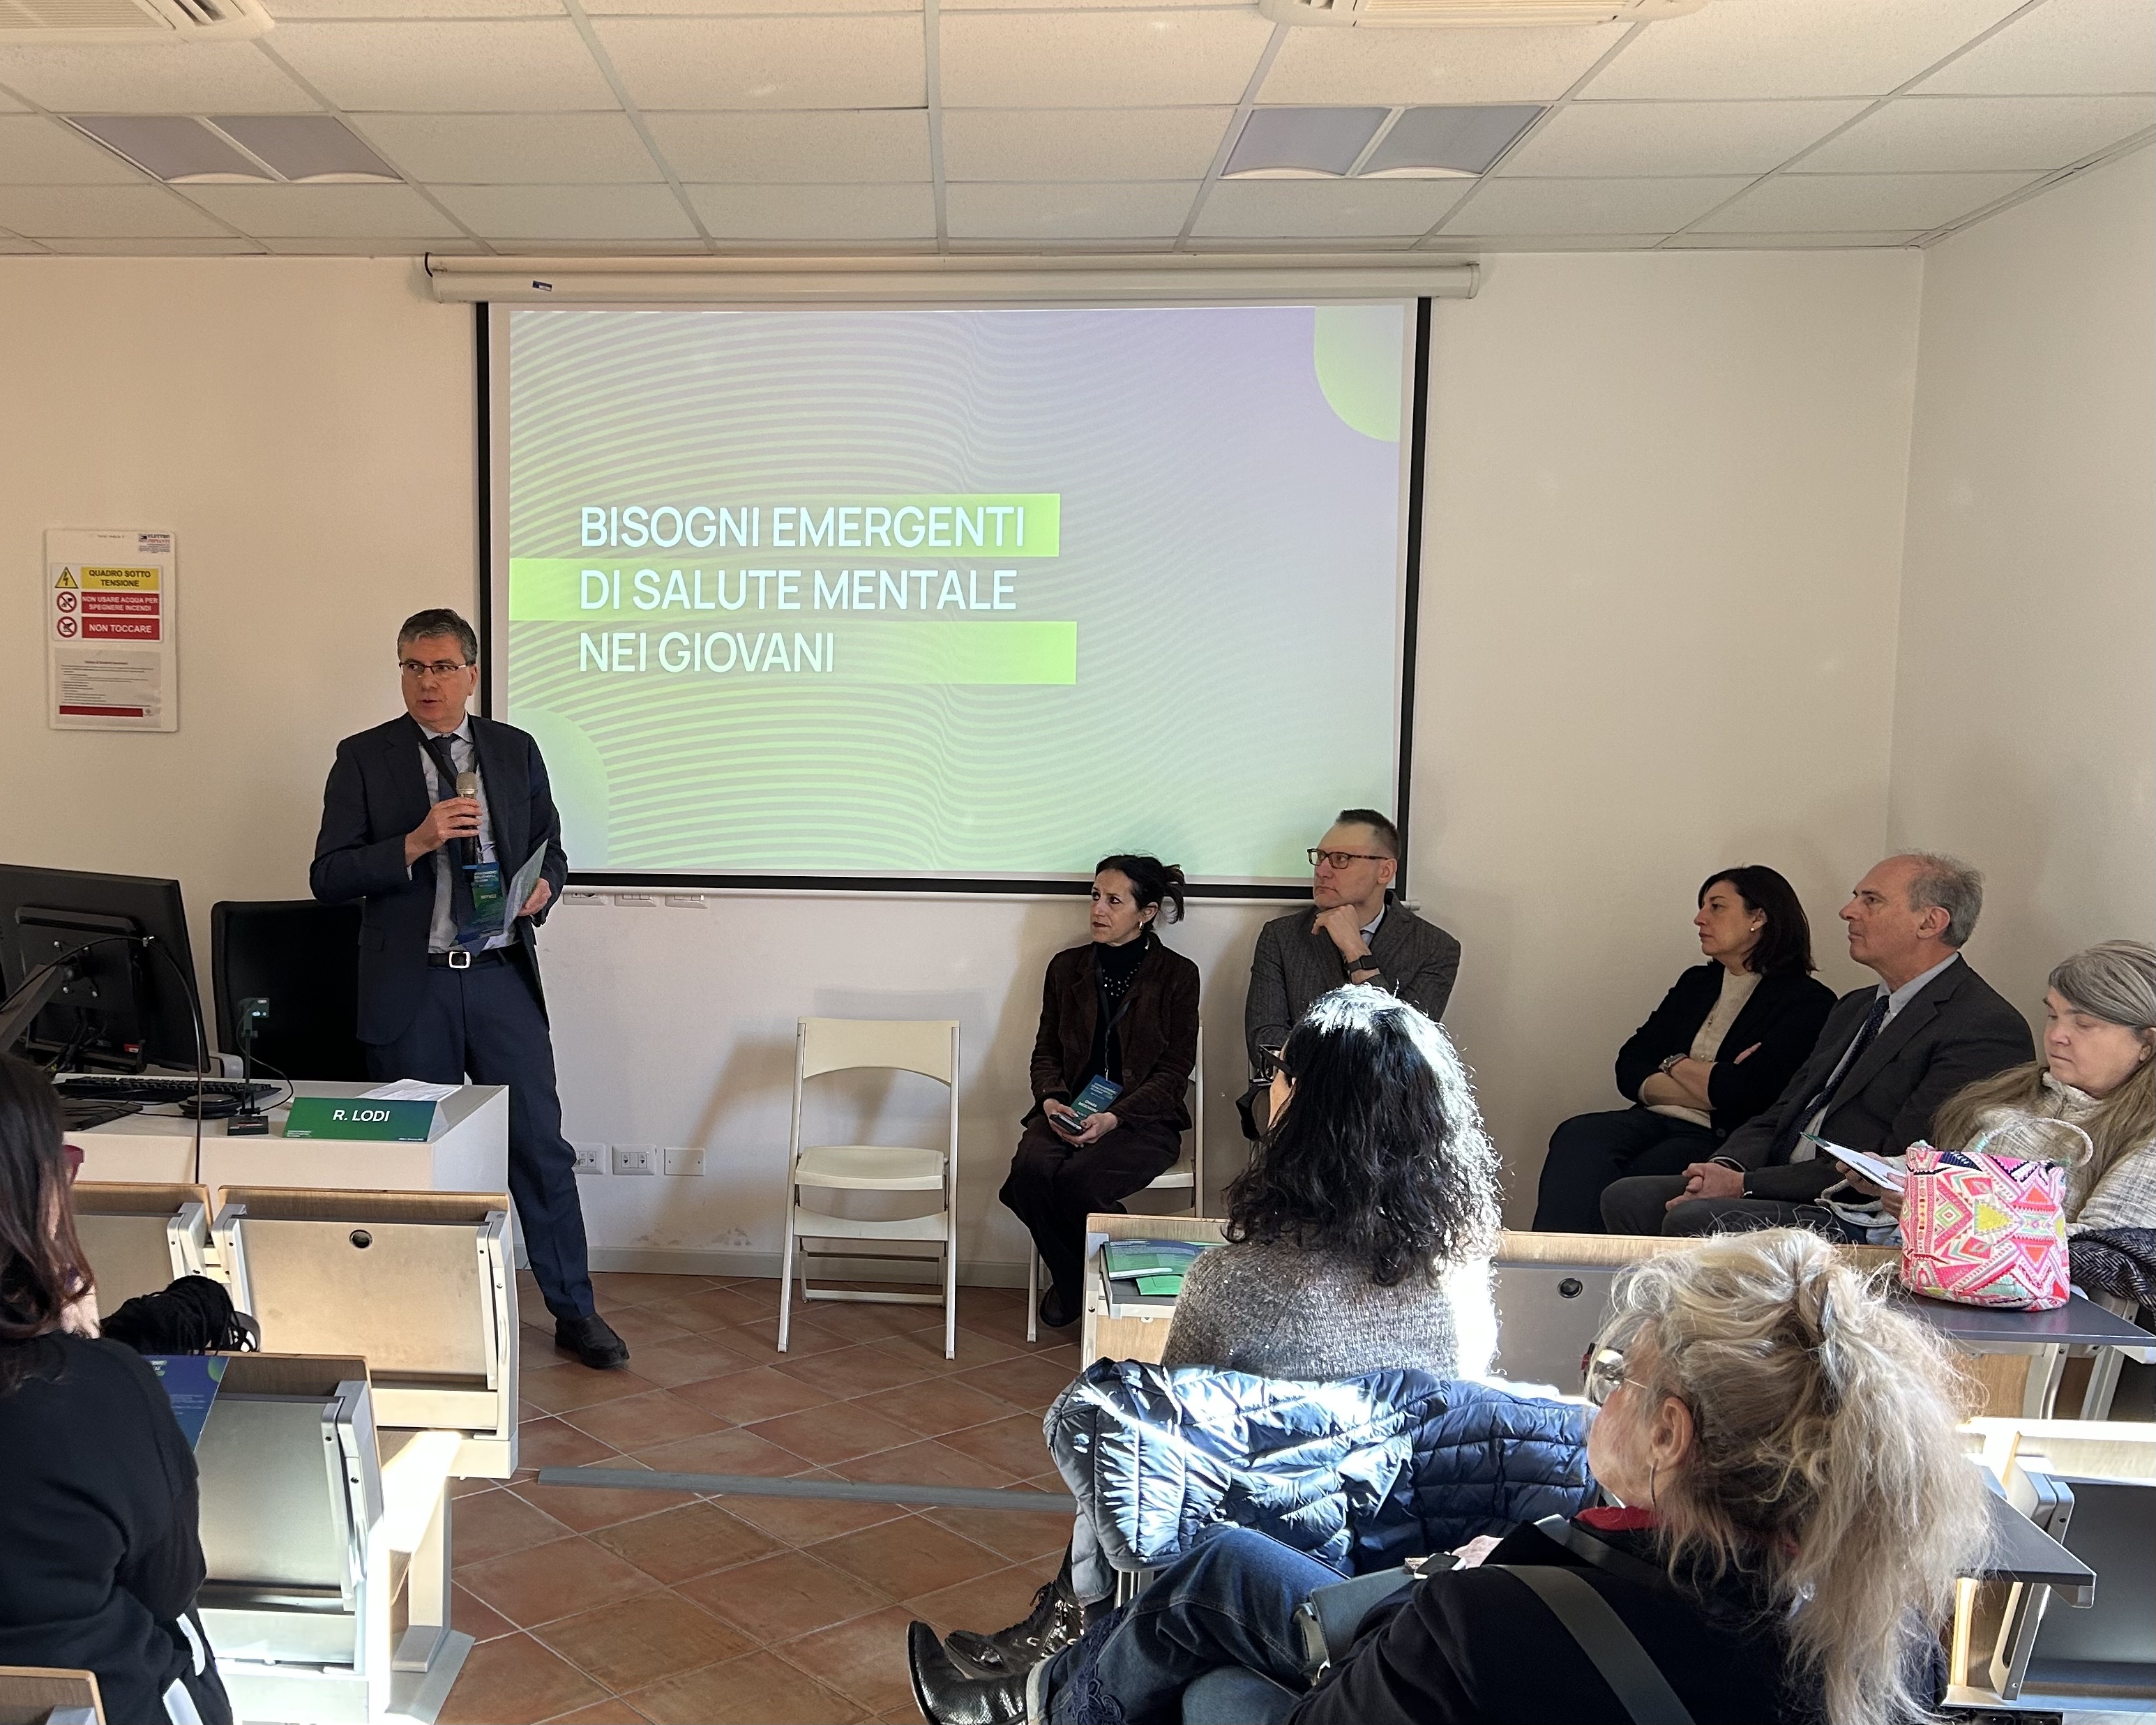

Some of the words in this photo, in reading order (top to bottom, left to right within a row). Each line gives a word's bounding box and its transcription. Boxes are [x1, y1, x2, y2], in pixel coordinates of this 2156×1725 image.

[581, 506, 760, 548] BISOGNI
[773, 506, 1024, 548] EMERGENTI
[89, 569, 123, 578] QUADRO
[100, 579, 140, 587] TENSIONE
[580, 569, 620, 610] DI
[633, 568, 801, 610] SALUTE
[813, 569, 1018, 610] MENTALE
[89, 624, 108, 633] NON
[110, 624, 152, 633] TOCCARE
[580, 632, 647, 672] NEI
[658, 631, 834, 673] GIOVANI
[333, 1109, 348, 1121] R.
[352, 1110, 391, 1122] LODI
